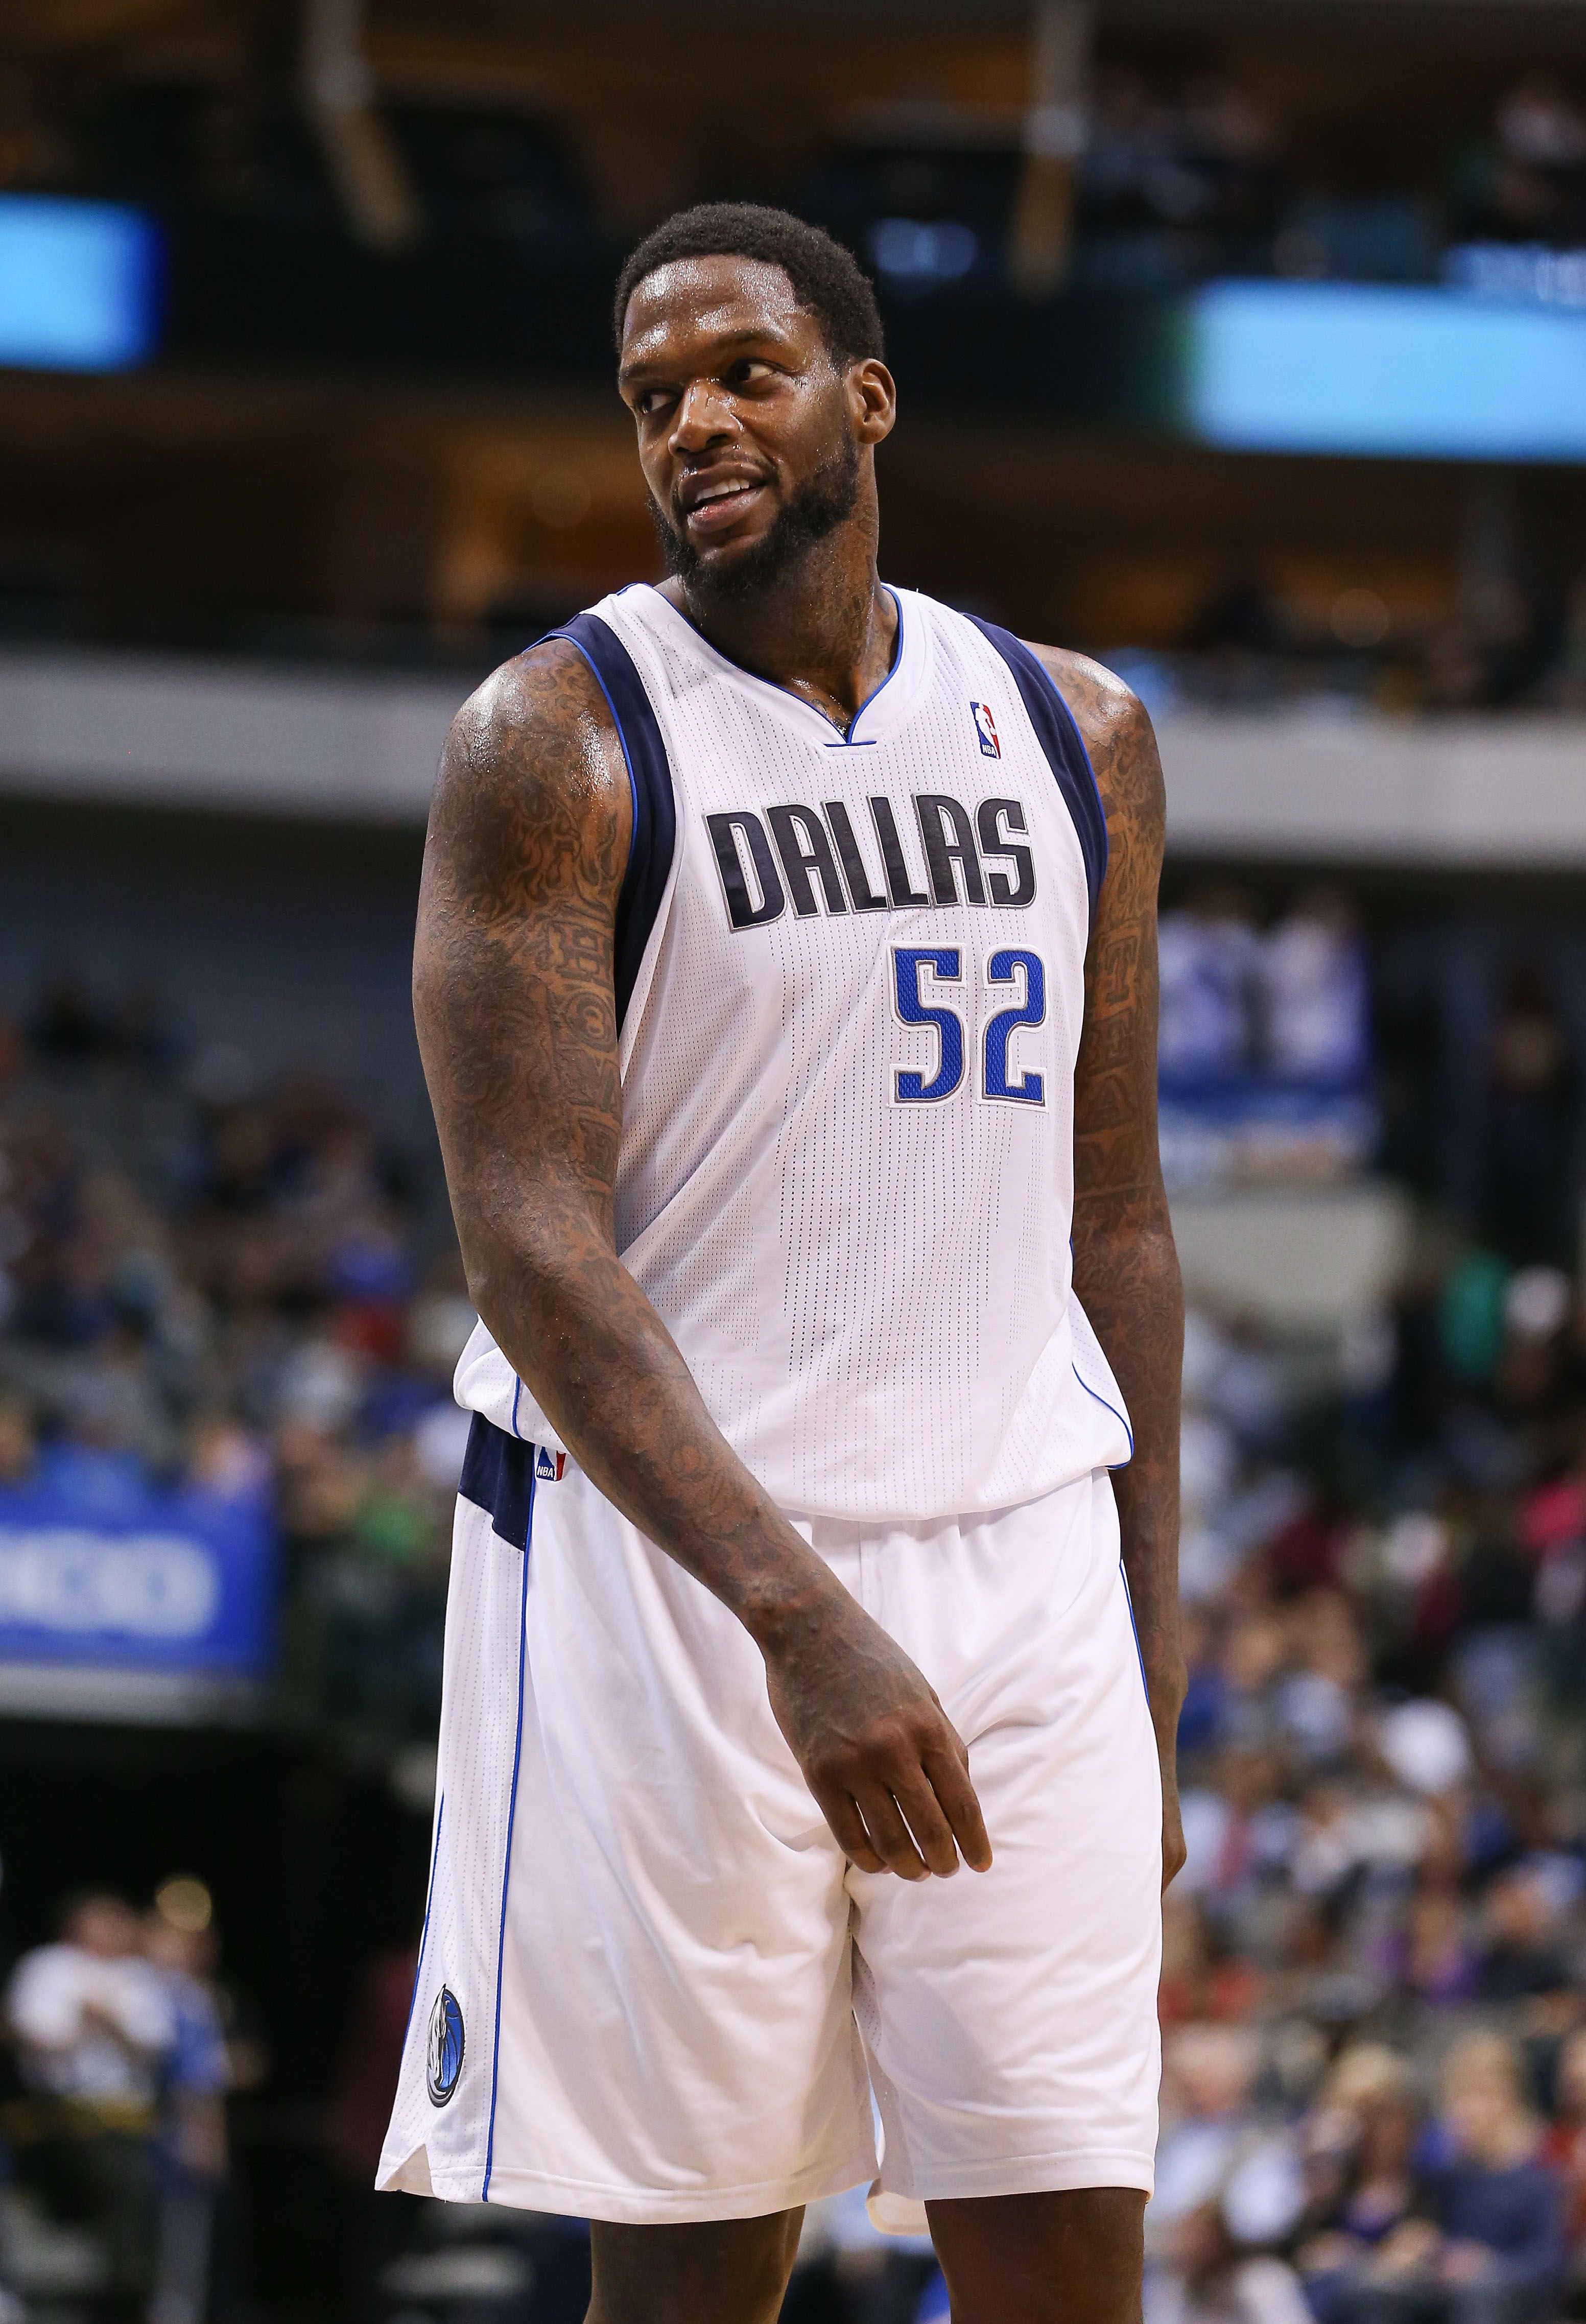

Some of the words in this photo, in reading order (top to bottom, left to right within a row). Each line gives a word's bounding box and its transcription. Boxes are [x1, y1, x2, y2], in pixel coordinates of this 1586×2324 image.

[982, 744, 996, 756] NBA
[702, 793, 1037, 933] DALLAS
[888, 943, 1050, 1110] 52
[537, 1465, 553, 1478] NBA
